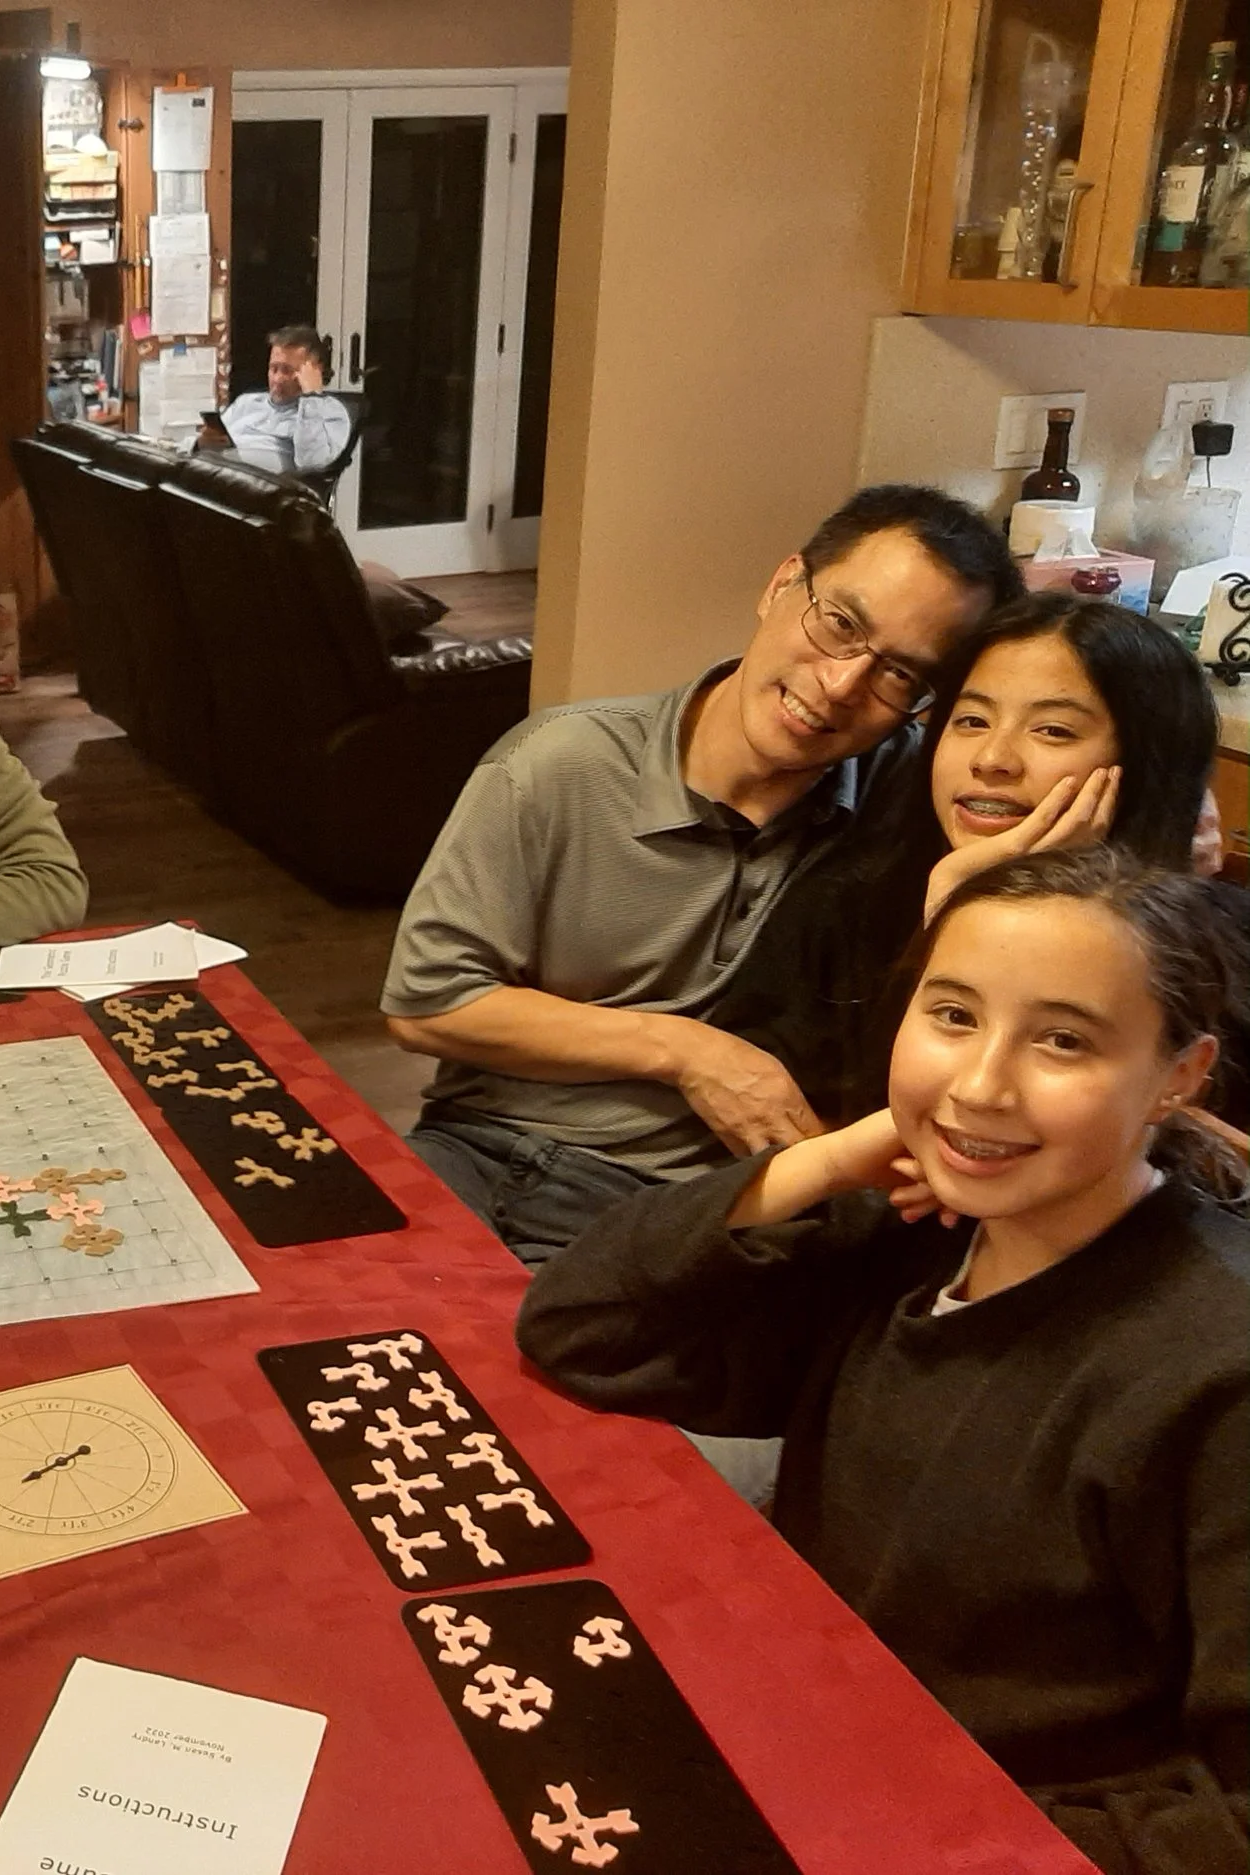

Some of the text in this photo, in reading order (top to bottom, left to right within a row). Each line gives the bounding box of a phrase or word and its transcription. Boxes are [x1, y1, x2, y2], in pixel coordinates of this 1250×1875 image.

[131, 1732, 167, 1748] Landry
[173, 1734, 225, 1752] November
[77, 1784, 239, 1841] Instructions
[39, 1856, 105, 1875] ame
